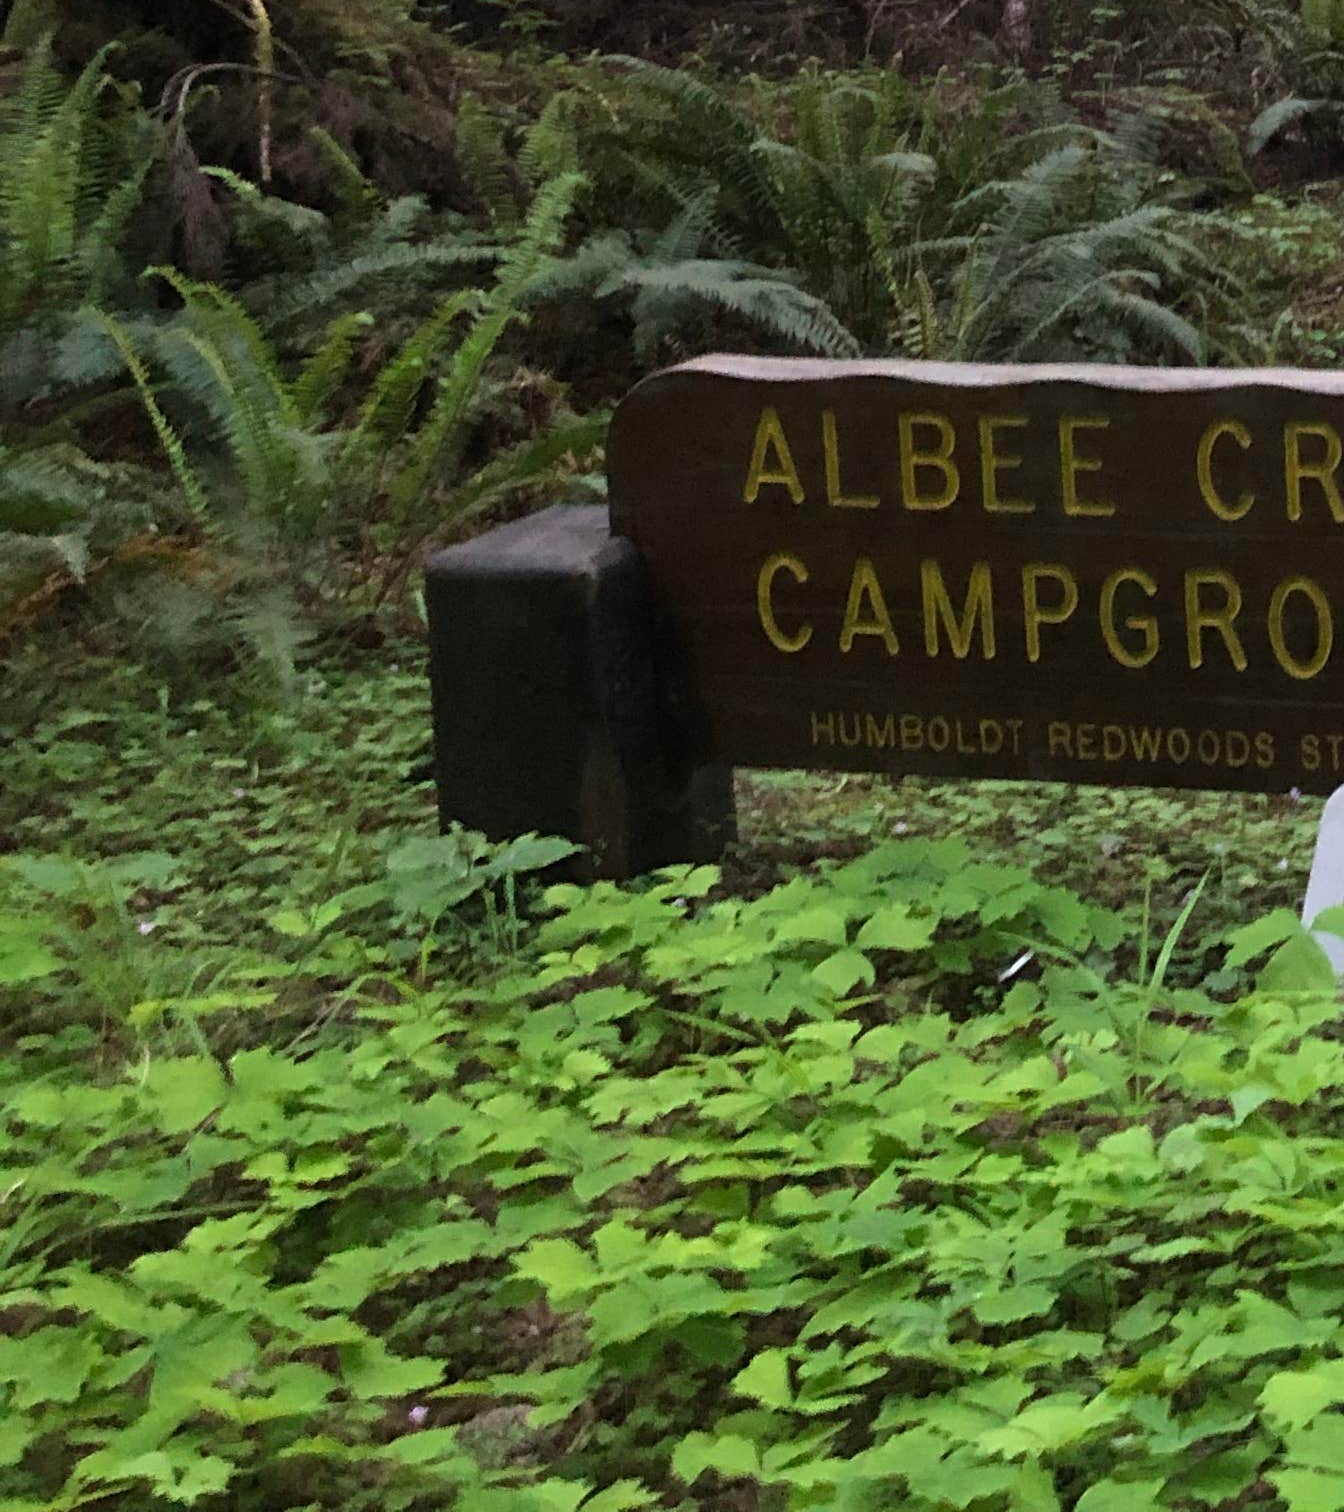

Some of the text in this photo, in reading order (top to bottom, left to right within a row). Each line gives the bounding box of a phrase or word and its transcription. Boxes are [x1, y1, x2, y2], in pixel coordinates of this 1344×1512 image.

[743, 407, 1116, 519] ALBEE
[809, 711, 1024, 757] HUMBOLDT
[1047, 722, 1276, 770] REDWOODS
